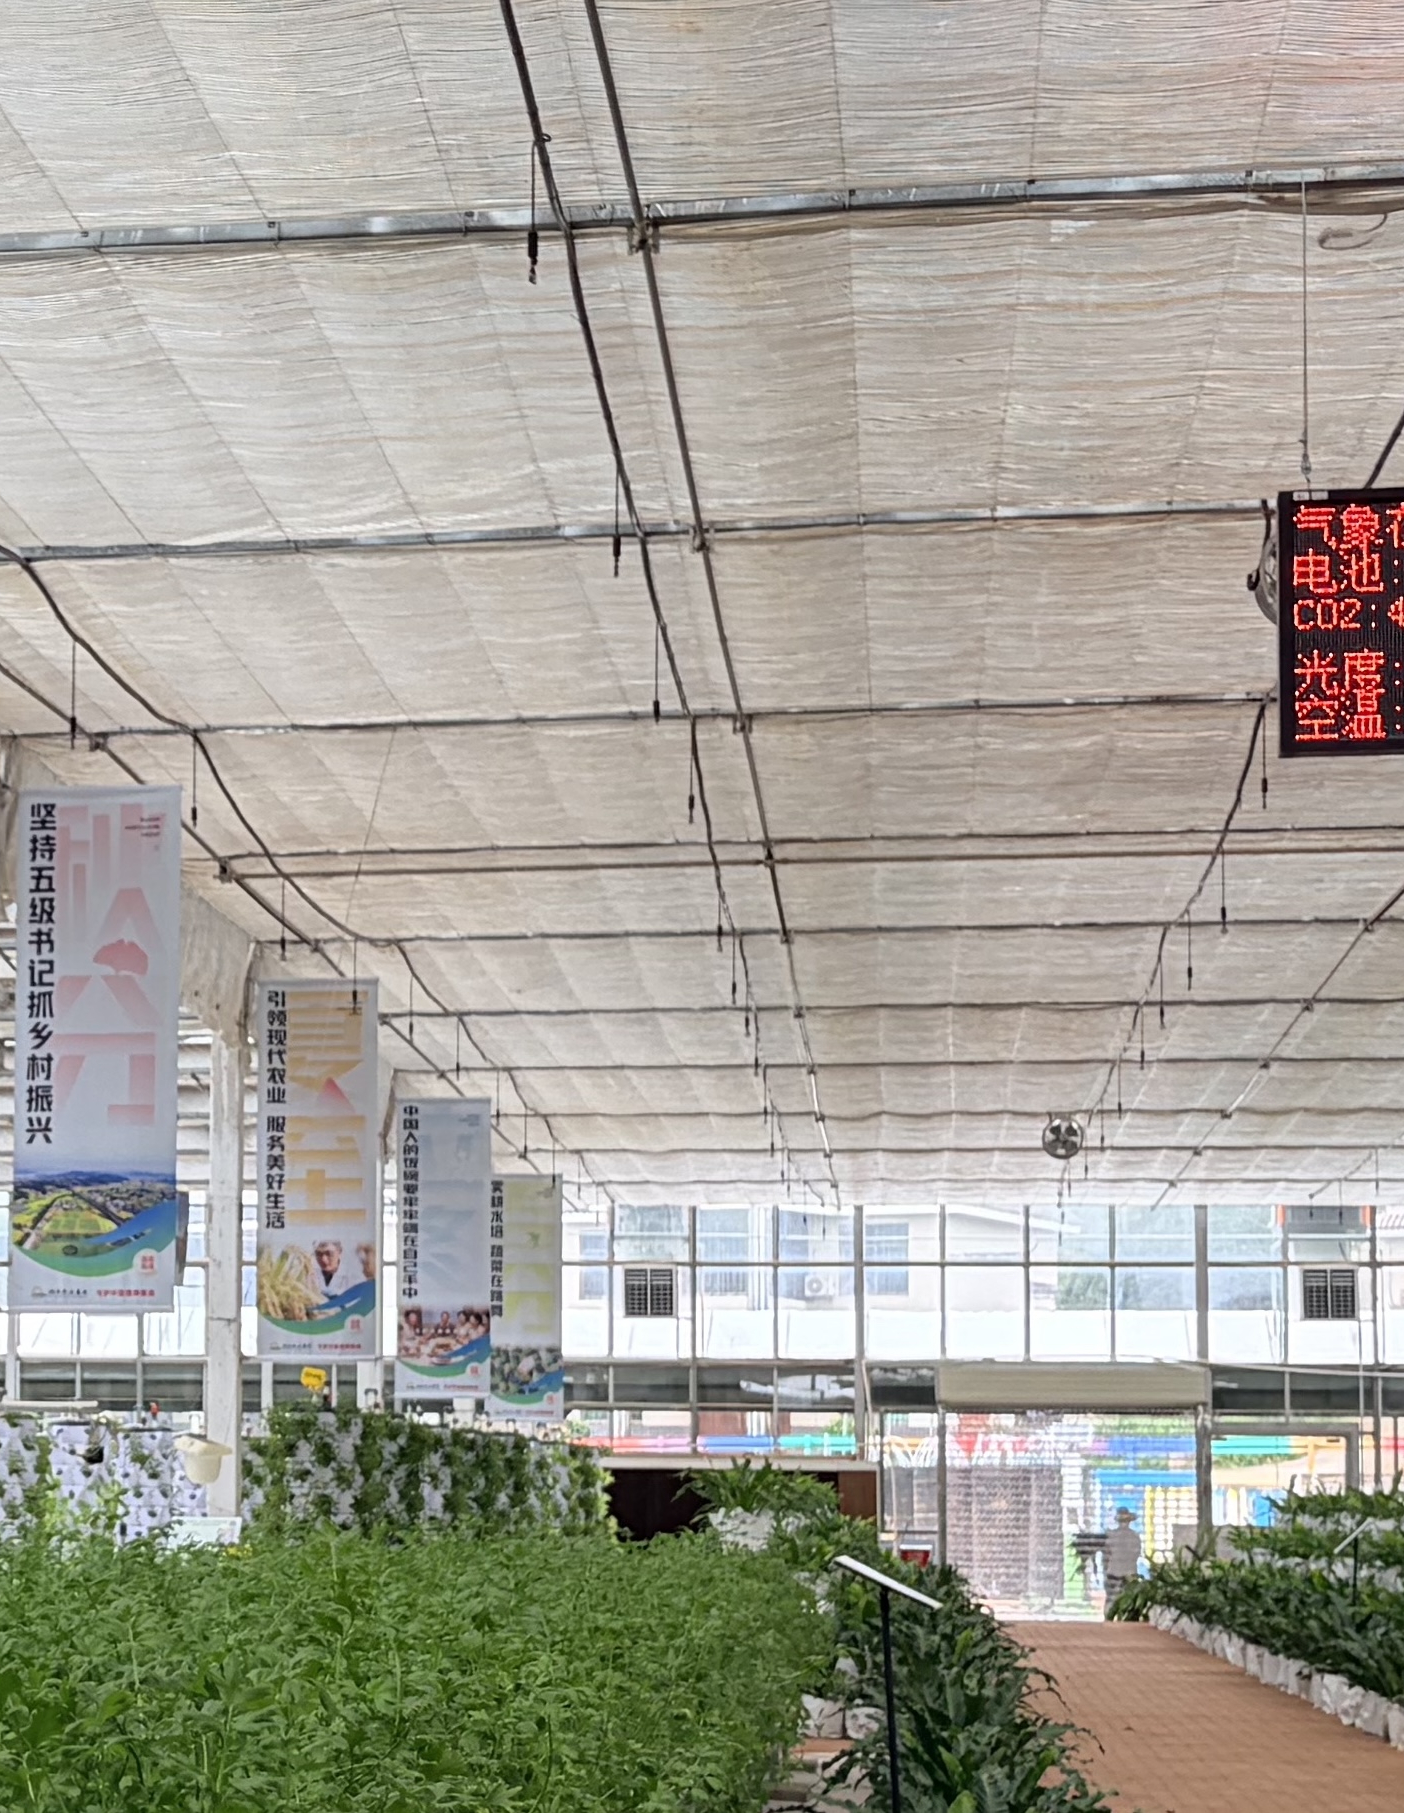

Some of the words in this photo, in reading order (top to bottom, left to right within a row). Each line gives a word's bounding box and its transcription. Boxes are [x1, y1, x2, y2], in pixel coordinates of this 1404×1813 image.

[26, 803, 57, 1144] 坚持五级书记抓乡村振兴
[266, 990, 287, 1104] 引领现代农业
[265, 1115, 286, 1229] 服务美好生活
